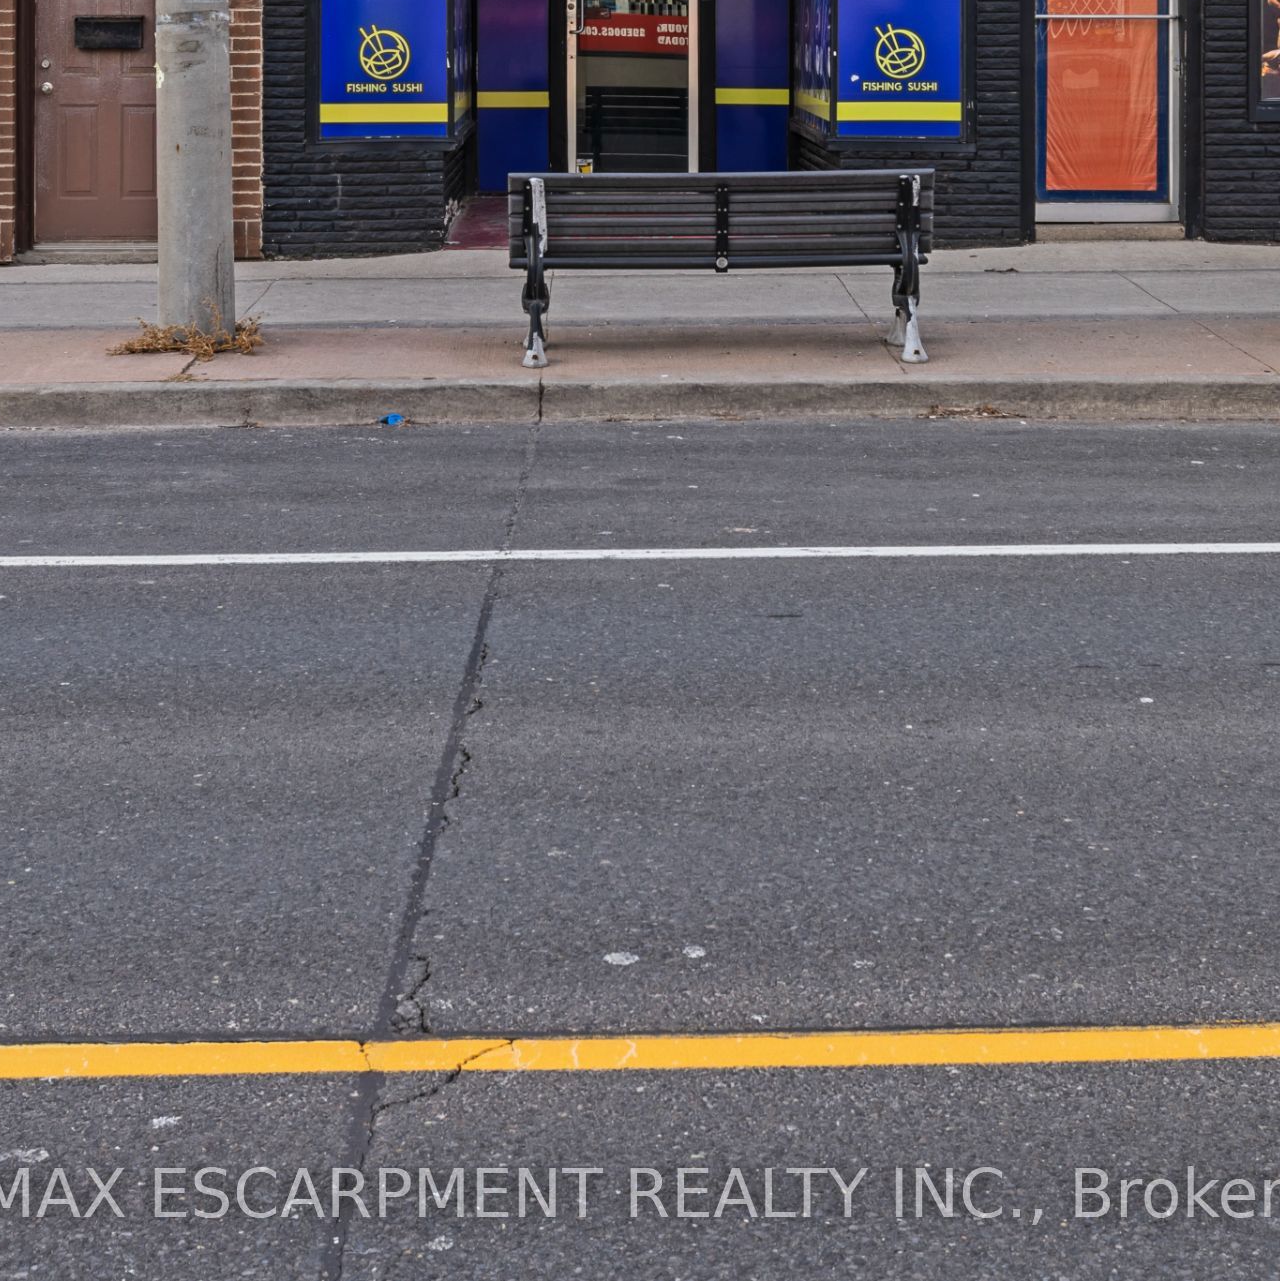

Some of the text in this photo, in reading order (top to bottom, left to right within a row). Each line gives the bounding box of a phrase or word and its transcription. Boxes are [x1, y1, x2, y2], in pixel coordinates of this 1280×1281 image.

[346, 83, 423, 93] FISHING SUSHI
[862, 82, 938, 92] FISHING SUSHI
